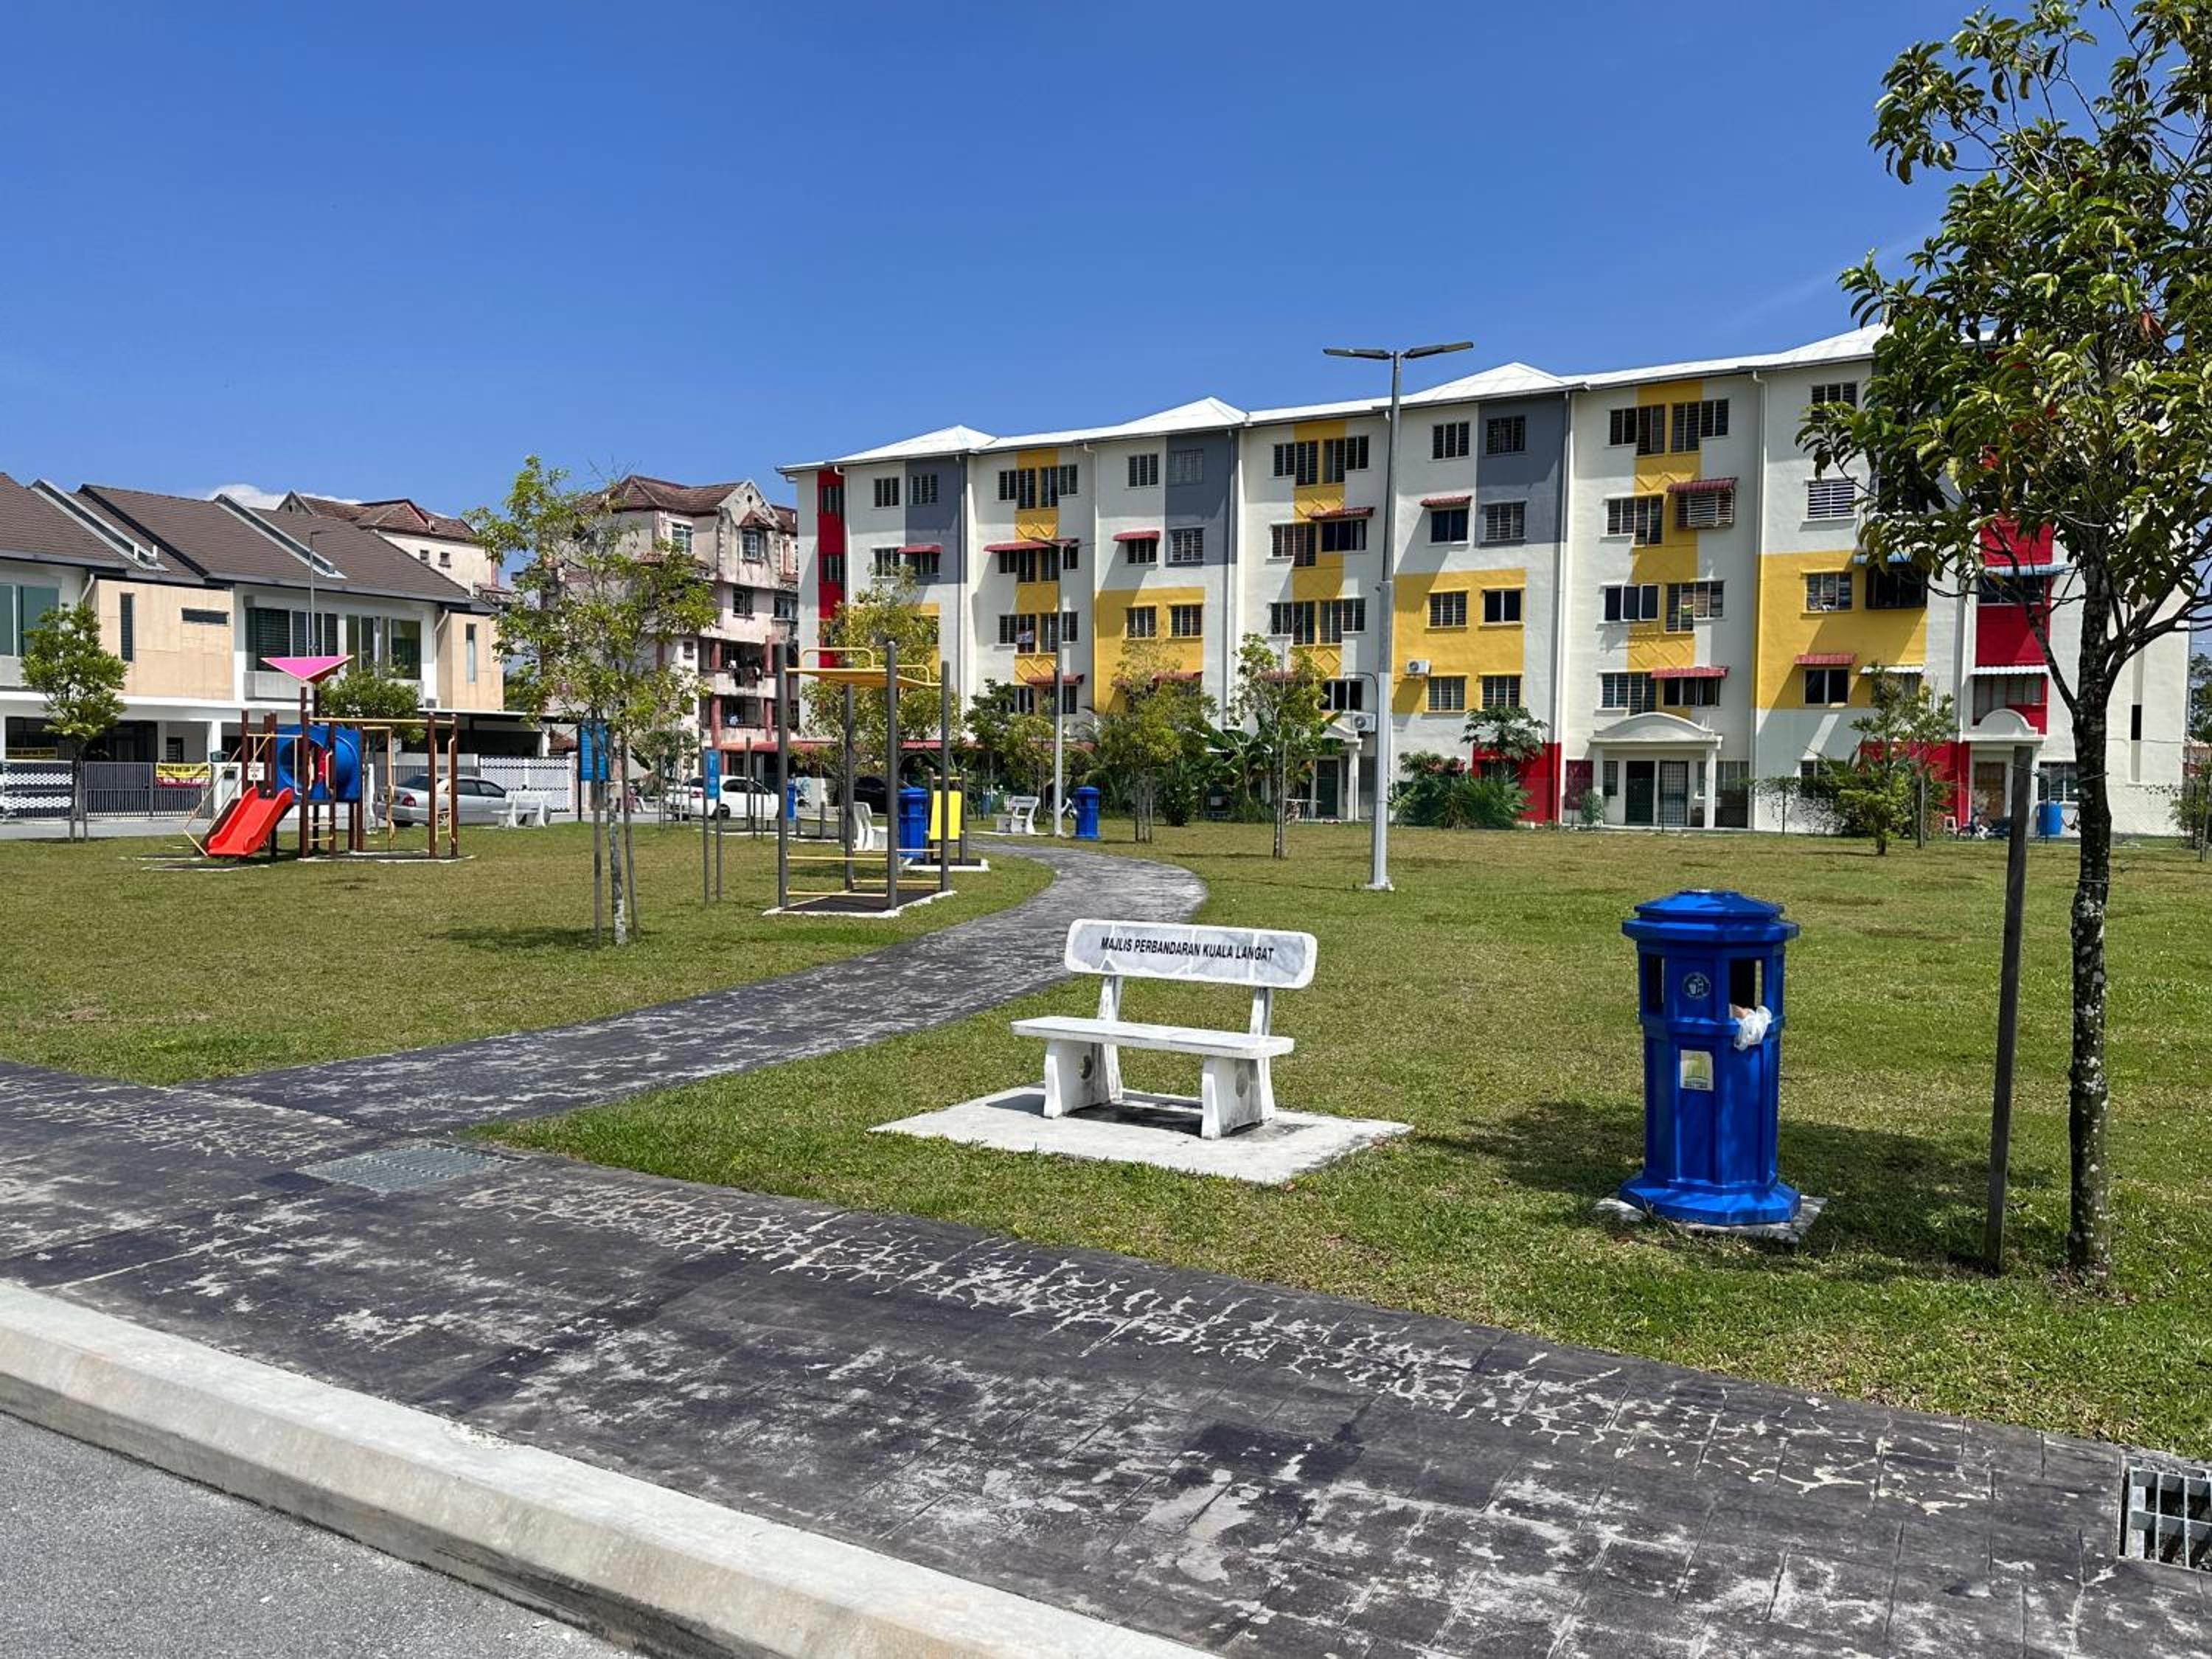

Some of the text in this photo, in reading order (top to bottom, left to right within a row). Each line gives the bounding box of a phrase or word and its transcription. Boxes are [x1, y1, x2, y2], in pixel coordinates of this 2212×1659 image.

[1101, 936, 1274, 962] MAJLIS PERBANDARAN KUALA LANGAT
